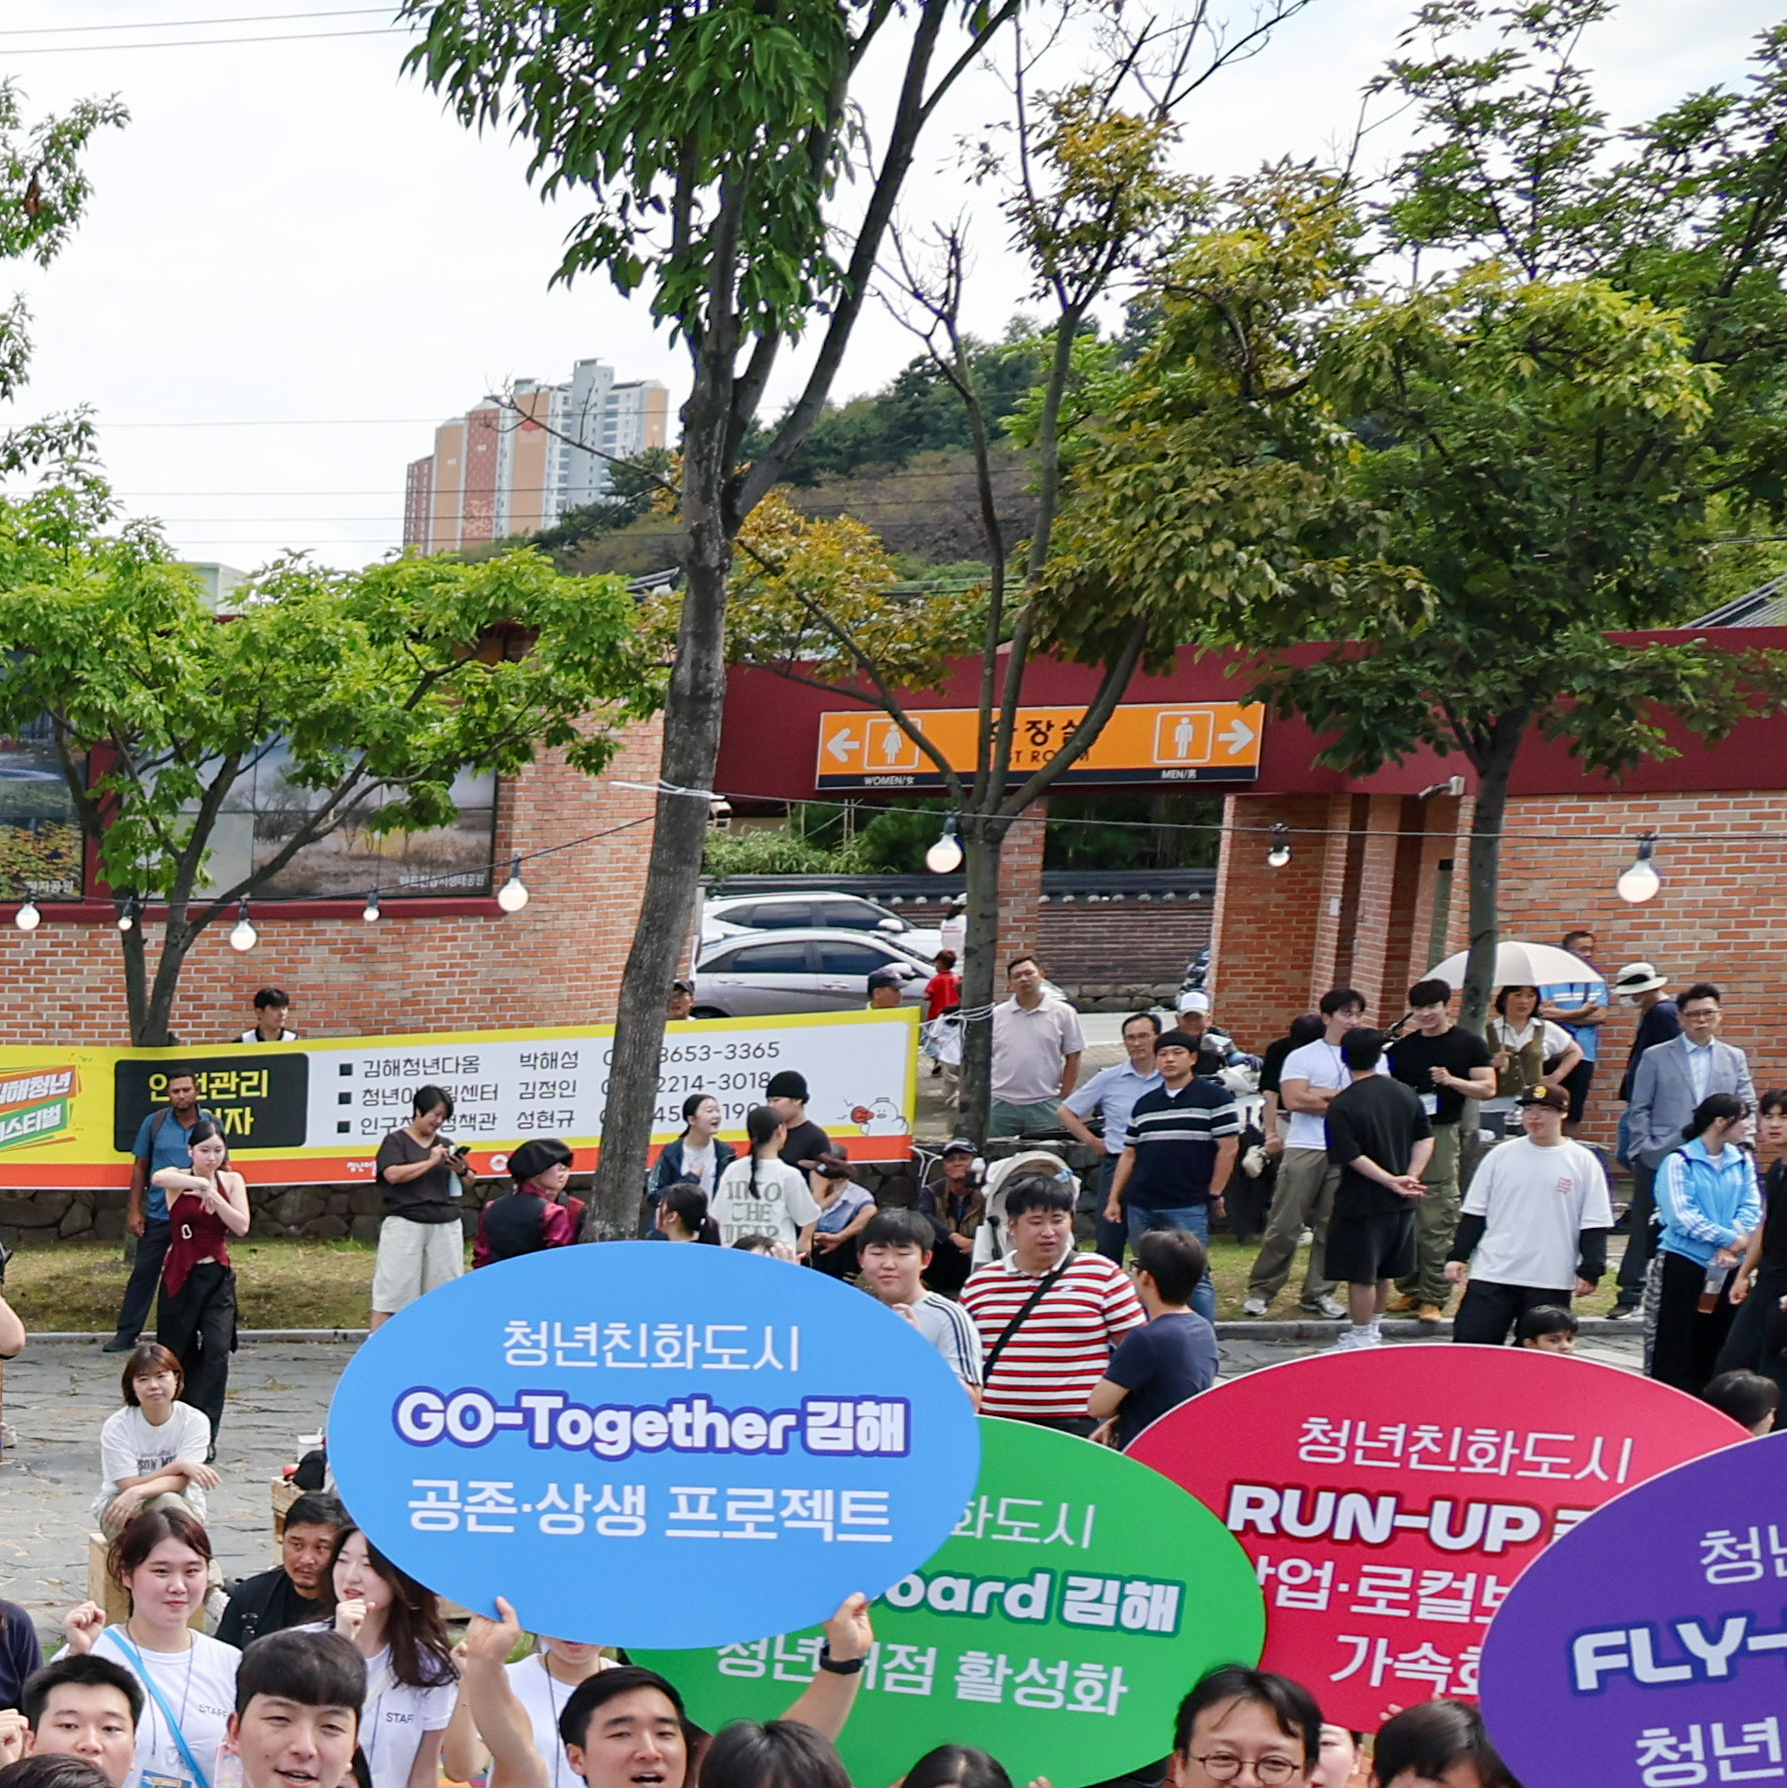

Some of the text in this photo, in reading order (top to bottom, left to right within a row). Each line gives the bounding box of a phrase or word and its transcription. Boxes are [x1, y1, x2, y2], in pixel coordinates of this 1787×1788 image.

[363, 1055, 480, 1078] 김해청년다옴
[520, 1051, 579, 1071] 박해성
[519, 1080, 577, 1100] 김정인
[517, 1110, 576, 1130] 성현규
[502, 1320, 801, 1373] 청년친화도시
[396, 1391, 907, 1456] GO-Together 김해
[1296, 1416, 1636, 1484] 청년친화도시
[407, 1477, 895, 1544] 공존·상생 프로젝트
[1226, 1484, 1542, 1553] RUN-UP
[1062, 1577, 1183, 1633] 김해
[954, 1649, 1129, 1717] 활성화
[385, 1712, 414, 1725] STAF
